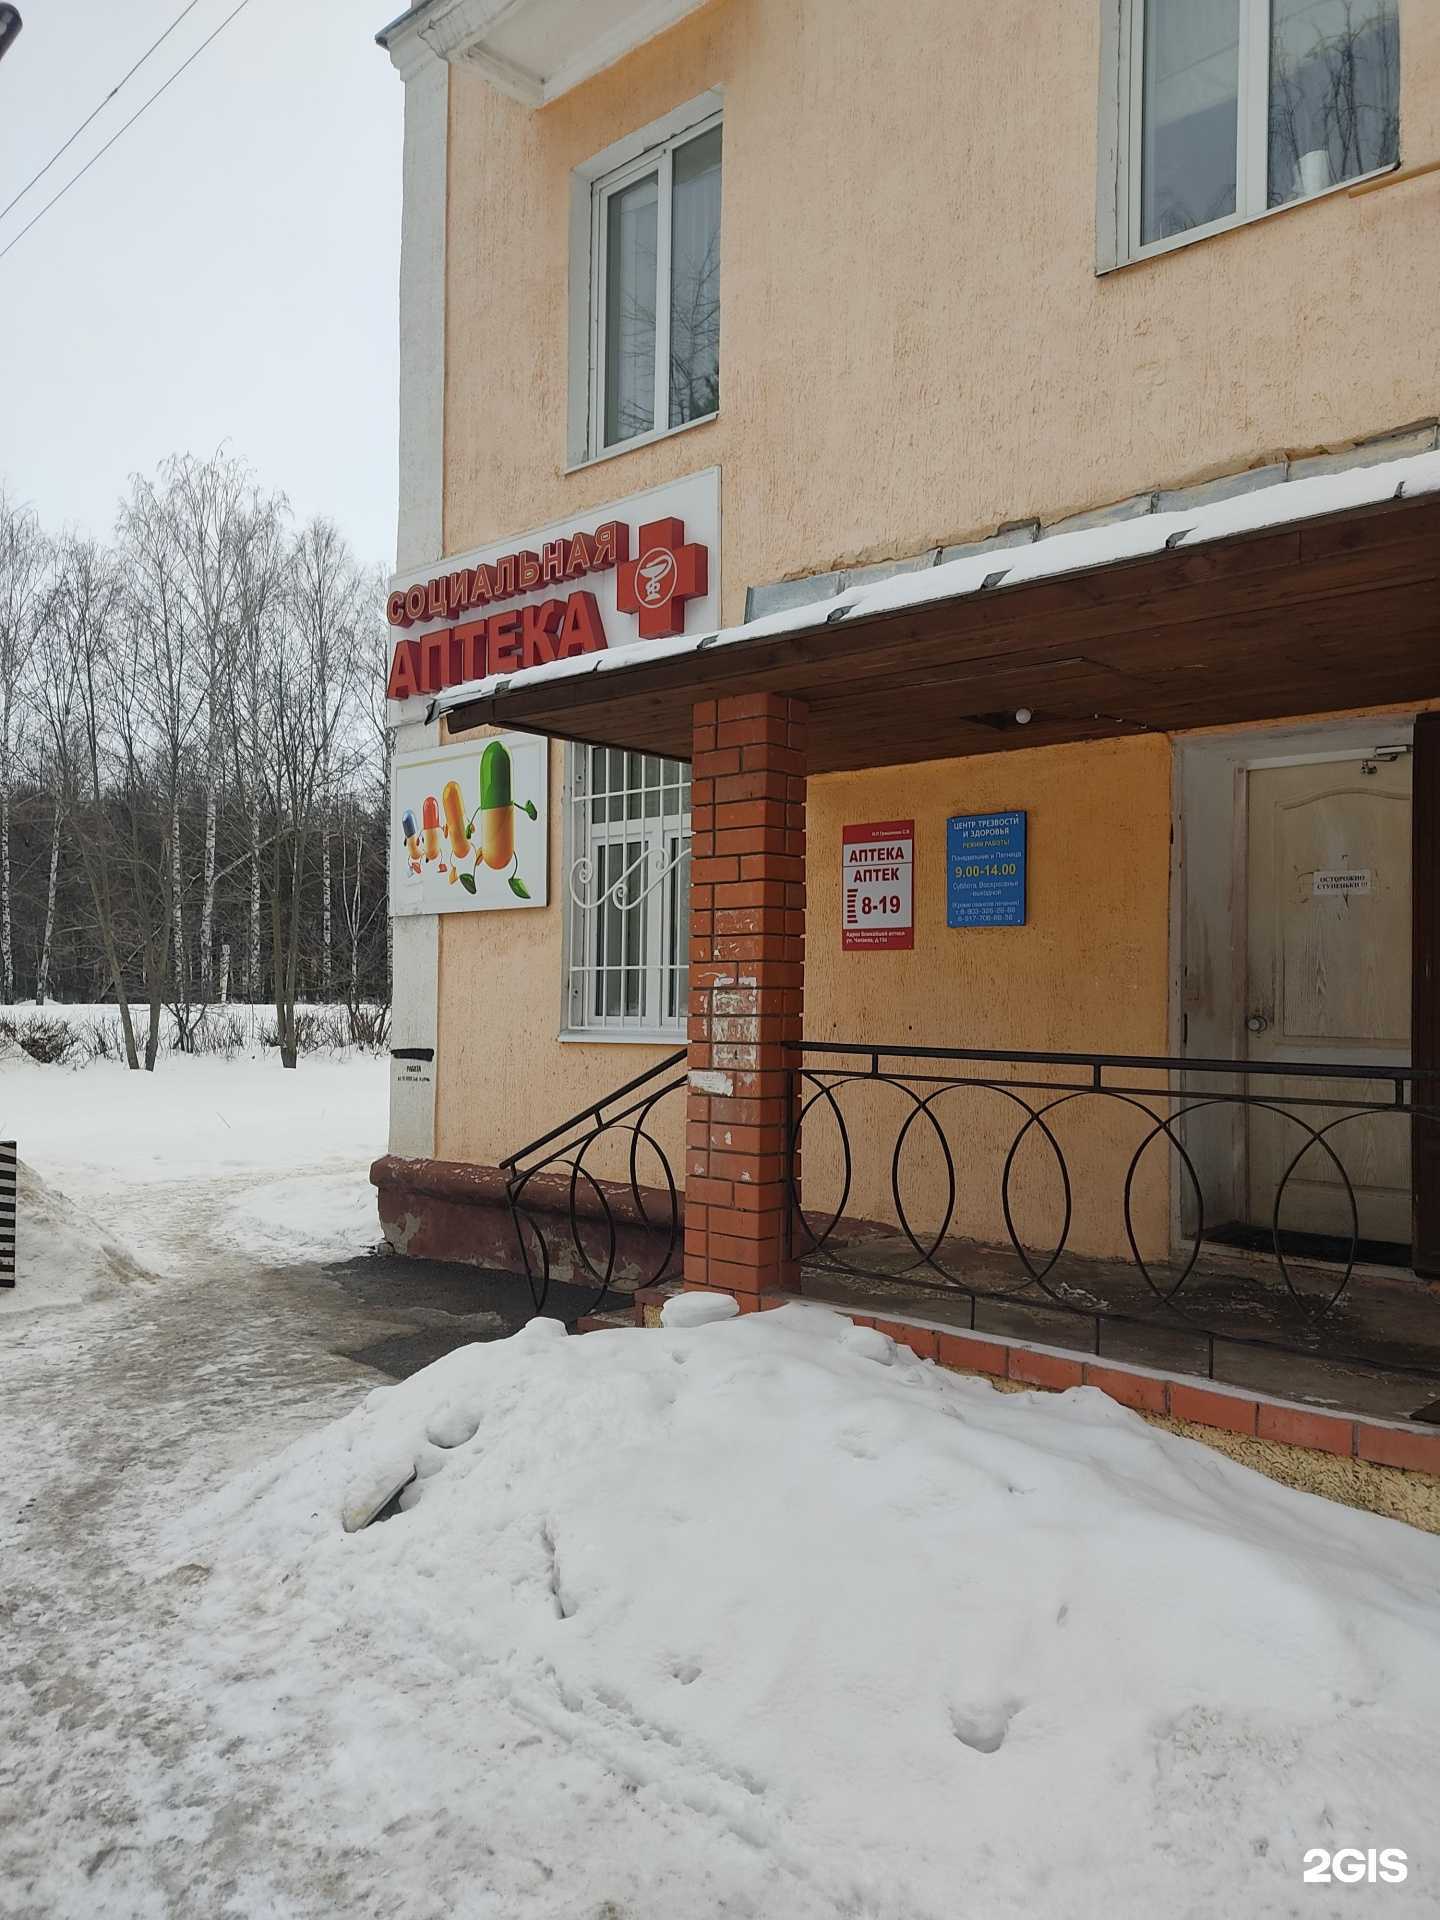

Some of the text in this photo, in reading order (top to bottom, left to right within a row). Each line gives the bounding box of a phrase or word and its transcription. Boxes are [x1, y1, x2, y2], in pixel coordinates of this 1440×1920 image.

[387, 520, 629, 628] СОЦИАЛЬНАЯ
[387, 590, 608, 700] АПТЕКА
[953, 817, 1019, 830] ЦЕНТР ТРЕЗВОСТИ
[970, 827, 1009, 839] ЗДОРОВЬЯ
[849, 846, 905, 863] АПТЕКА
[853, 867, 900, 883] АПТЕК
[954, 863, 1017, 878] 9.00-14.00
[1320, 875, 1365, 883] ОСТОРОЖНО
[861, 895, 901, 915] 8-19
